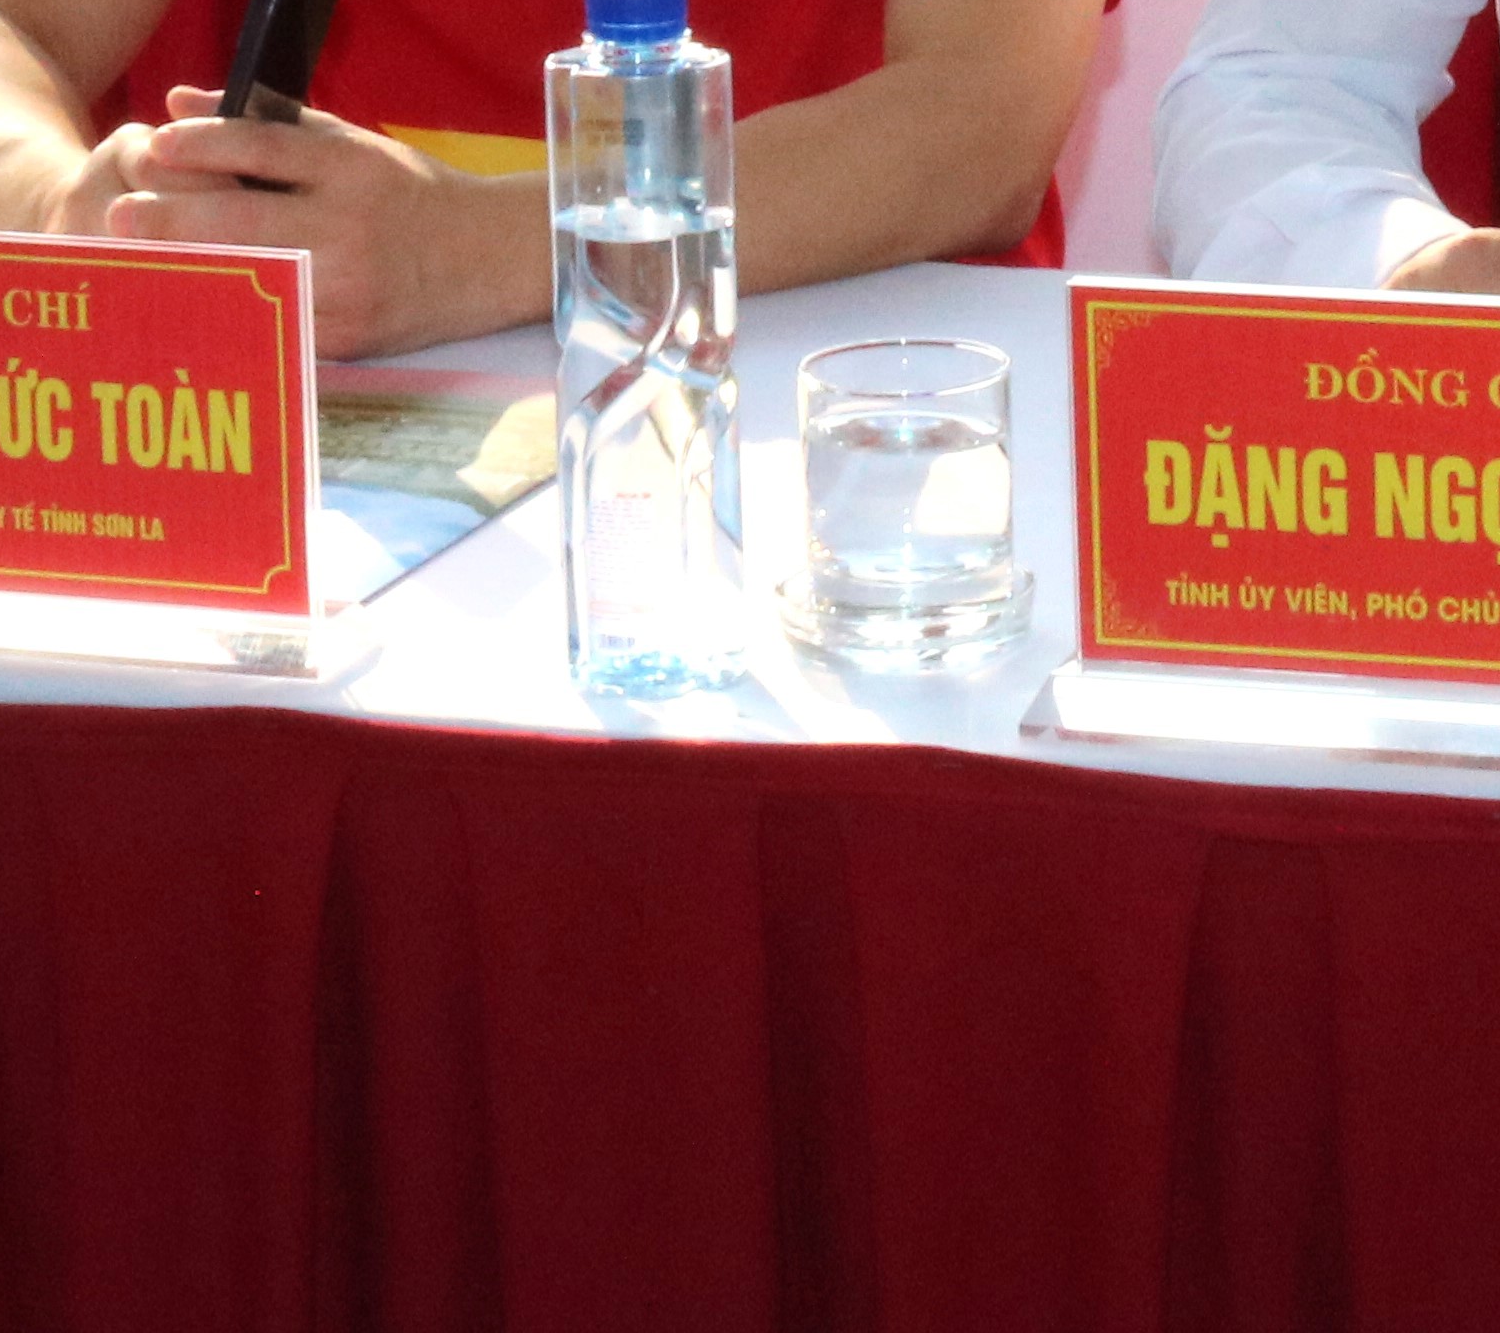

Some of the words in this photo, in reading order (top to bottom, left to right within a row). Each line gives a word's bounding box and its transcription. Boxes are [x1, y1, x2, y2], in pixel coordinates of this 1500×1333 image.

[3, 282, 90, 331] CHÍ
[1304, 348, 1469, 410] ĐỒNG
[90, 368, 253, 475] TOÀN
[1143, 424, 1349, 548] ĐẶNG
[92, 513, 135, 539] SƠN
[138, 515, 165, 541] LA
[1165, 571, 1230, 609] TỈNH
[1238, 575, 1276, 611] ỦY
[1284, 582, 1358, 622] VIÊN,
[1365, 588, 1429, 621] PHÓ
